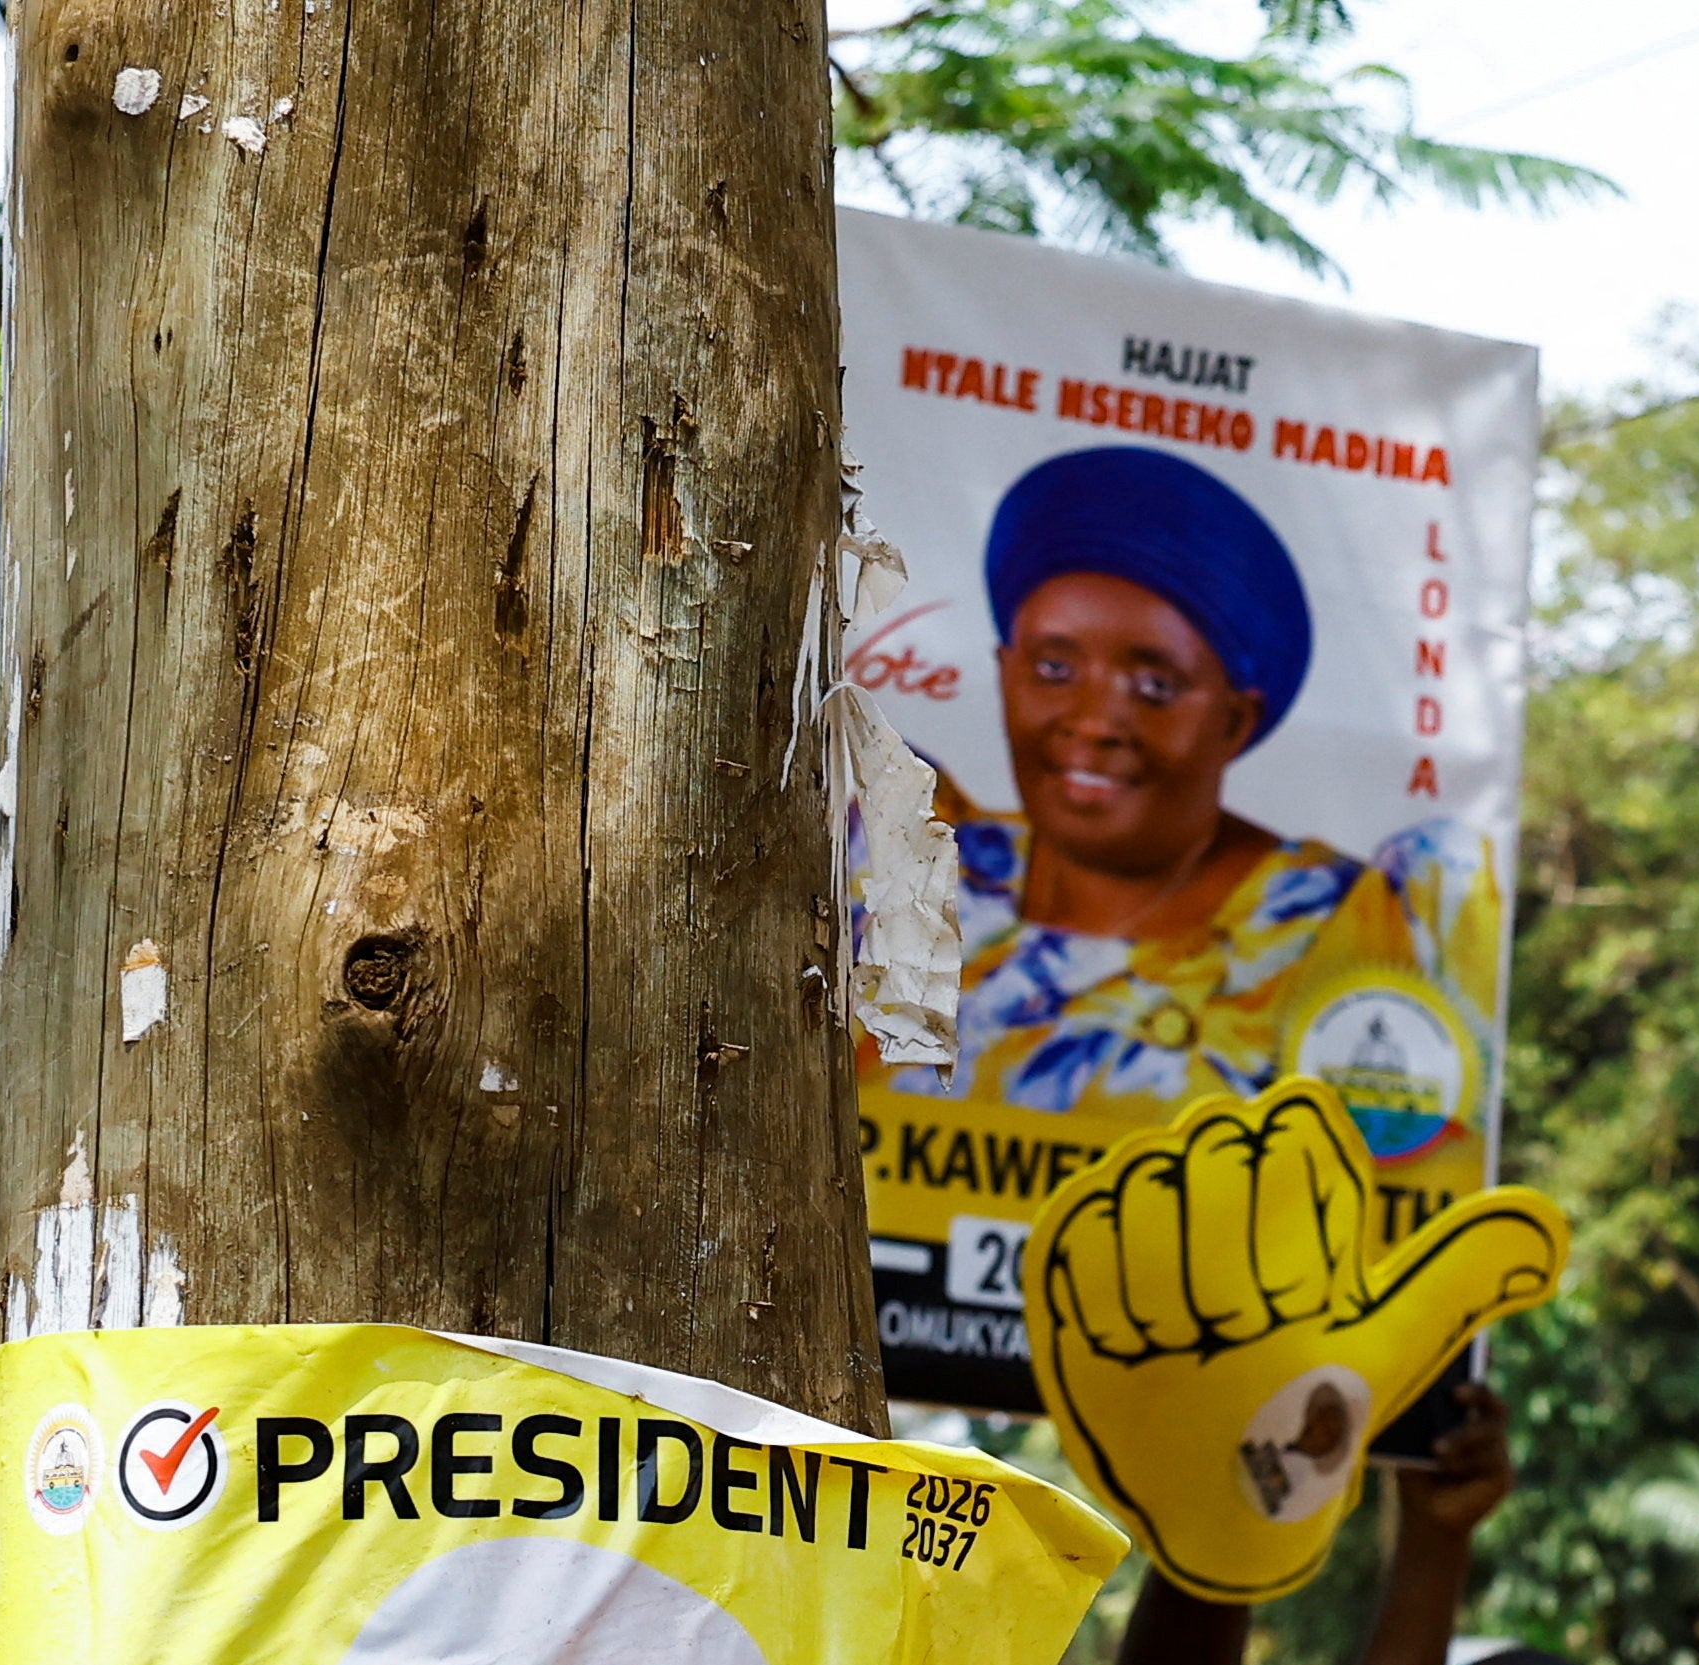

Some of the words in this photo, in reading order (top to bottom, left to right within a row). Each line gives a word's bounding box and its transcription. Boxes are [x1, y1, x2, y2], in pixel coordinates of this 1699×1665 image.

[1122, 335, 1254, 393] HAJJAT
[902, 345, 1042, 413] NTALE
[1056, 376, 1256, 453] NSEREKO
[1273, 417, 1451, 487] MADINA
[257, 1413, 889, 1550] PRESIDENT
[906, 1473, 997, 1527] 2026
